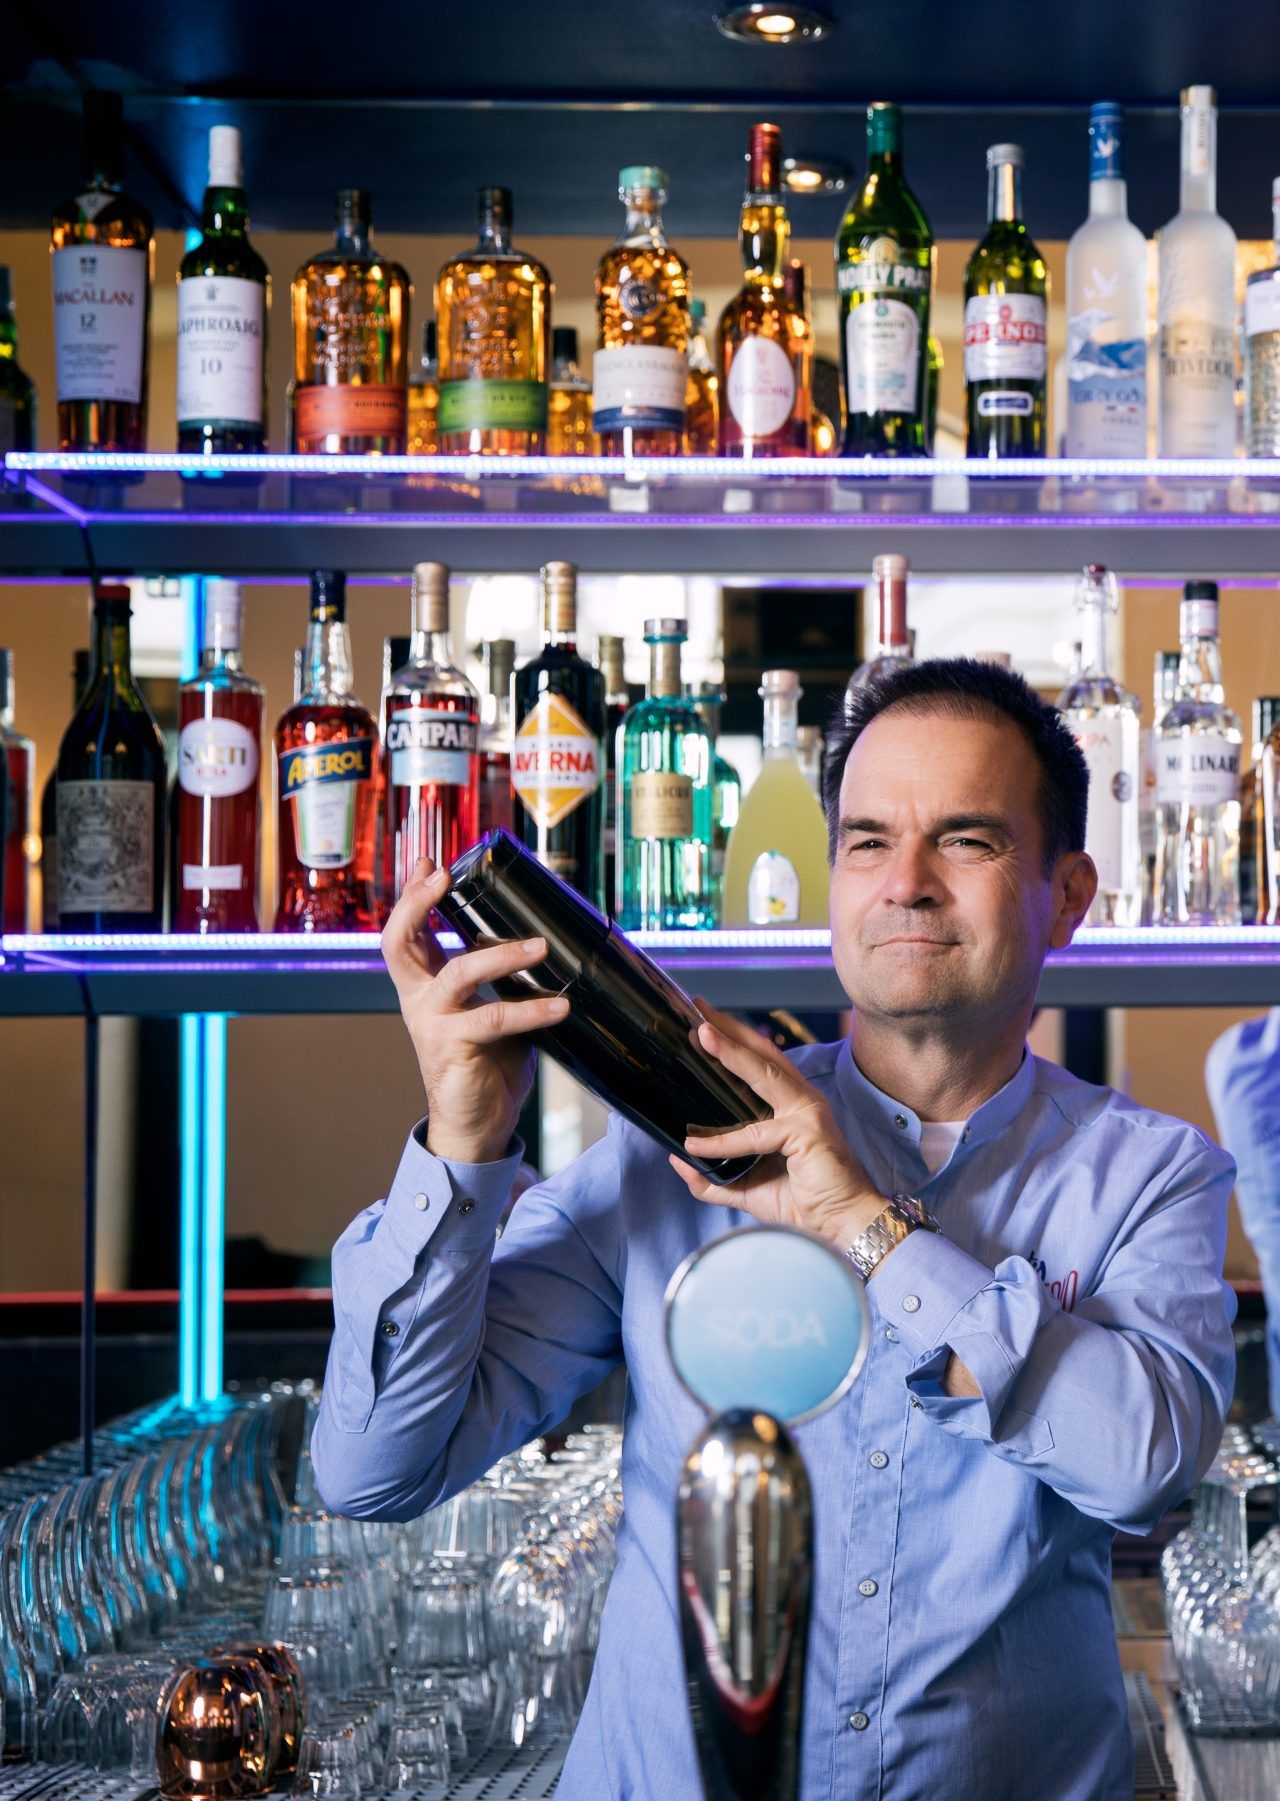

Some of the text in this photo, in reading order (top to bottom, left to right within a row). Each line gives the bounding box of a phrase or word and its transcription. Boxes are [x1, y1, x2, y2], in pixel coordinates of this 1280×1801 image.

[178, 316, 260, 337] APHROAIG
[515, 751, 596, 774] AVRNA
[706, 1309, 829, 1350] SODA
